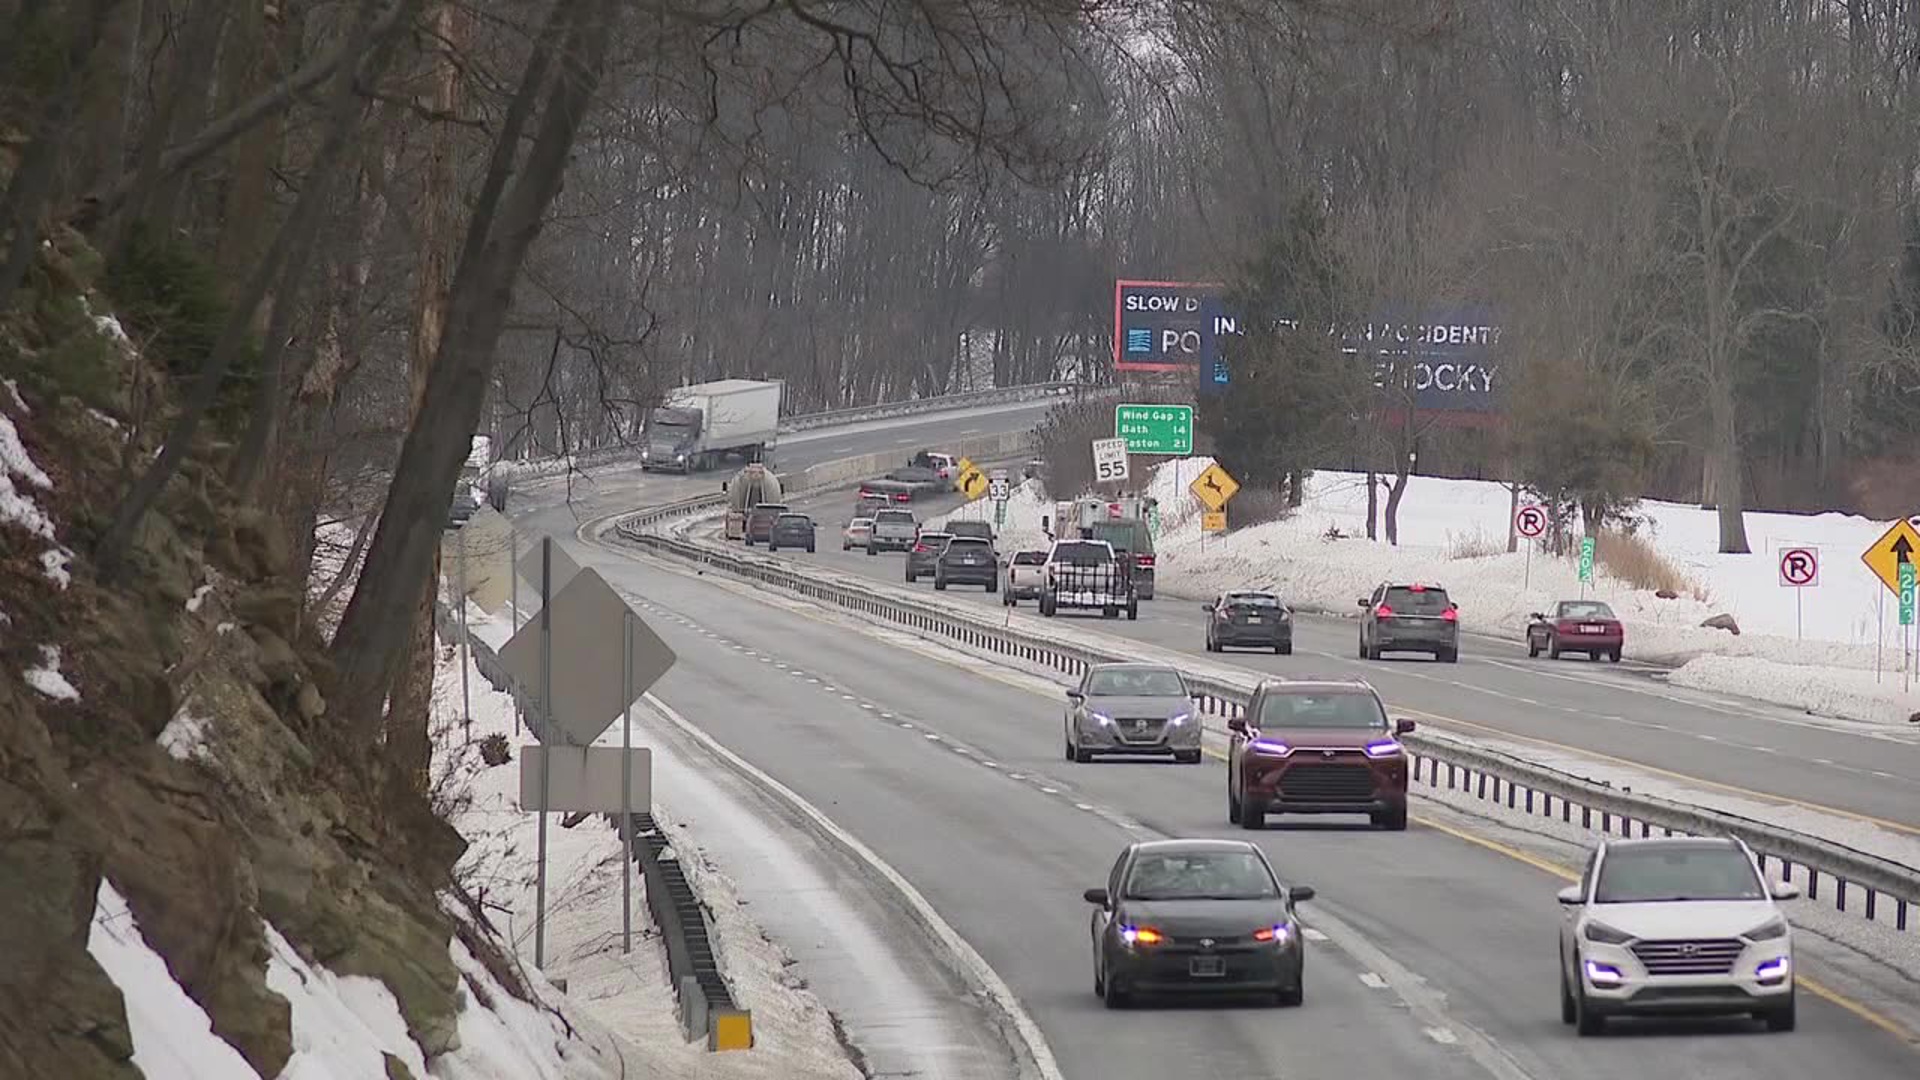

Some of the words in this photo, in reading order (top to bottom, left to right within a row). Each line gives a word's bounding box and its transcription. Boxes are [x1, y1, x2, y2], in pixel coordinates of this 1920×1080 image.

[1126, 294, 1179, 312] SLOW
[1122, 409, 1149, 421] Wind
[1152, 410, 1174, 422] Gap
[1178, 410, 1186, 421] 3
[1121, 424, 1148, 434] Bath
[1173, 425, 1186, 434] 14
[1095, 440, 1123, 451] SPEED
[1173, 439, 1186, 448] 21
[1099, 451, 1121, 461] LIMIT
[1099, 459, 1126, 478] 55
[991, 484, 1008, 497] 33
